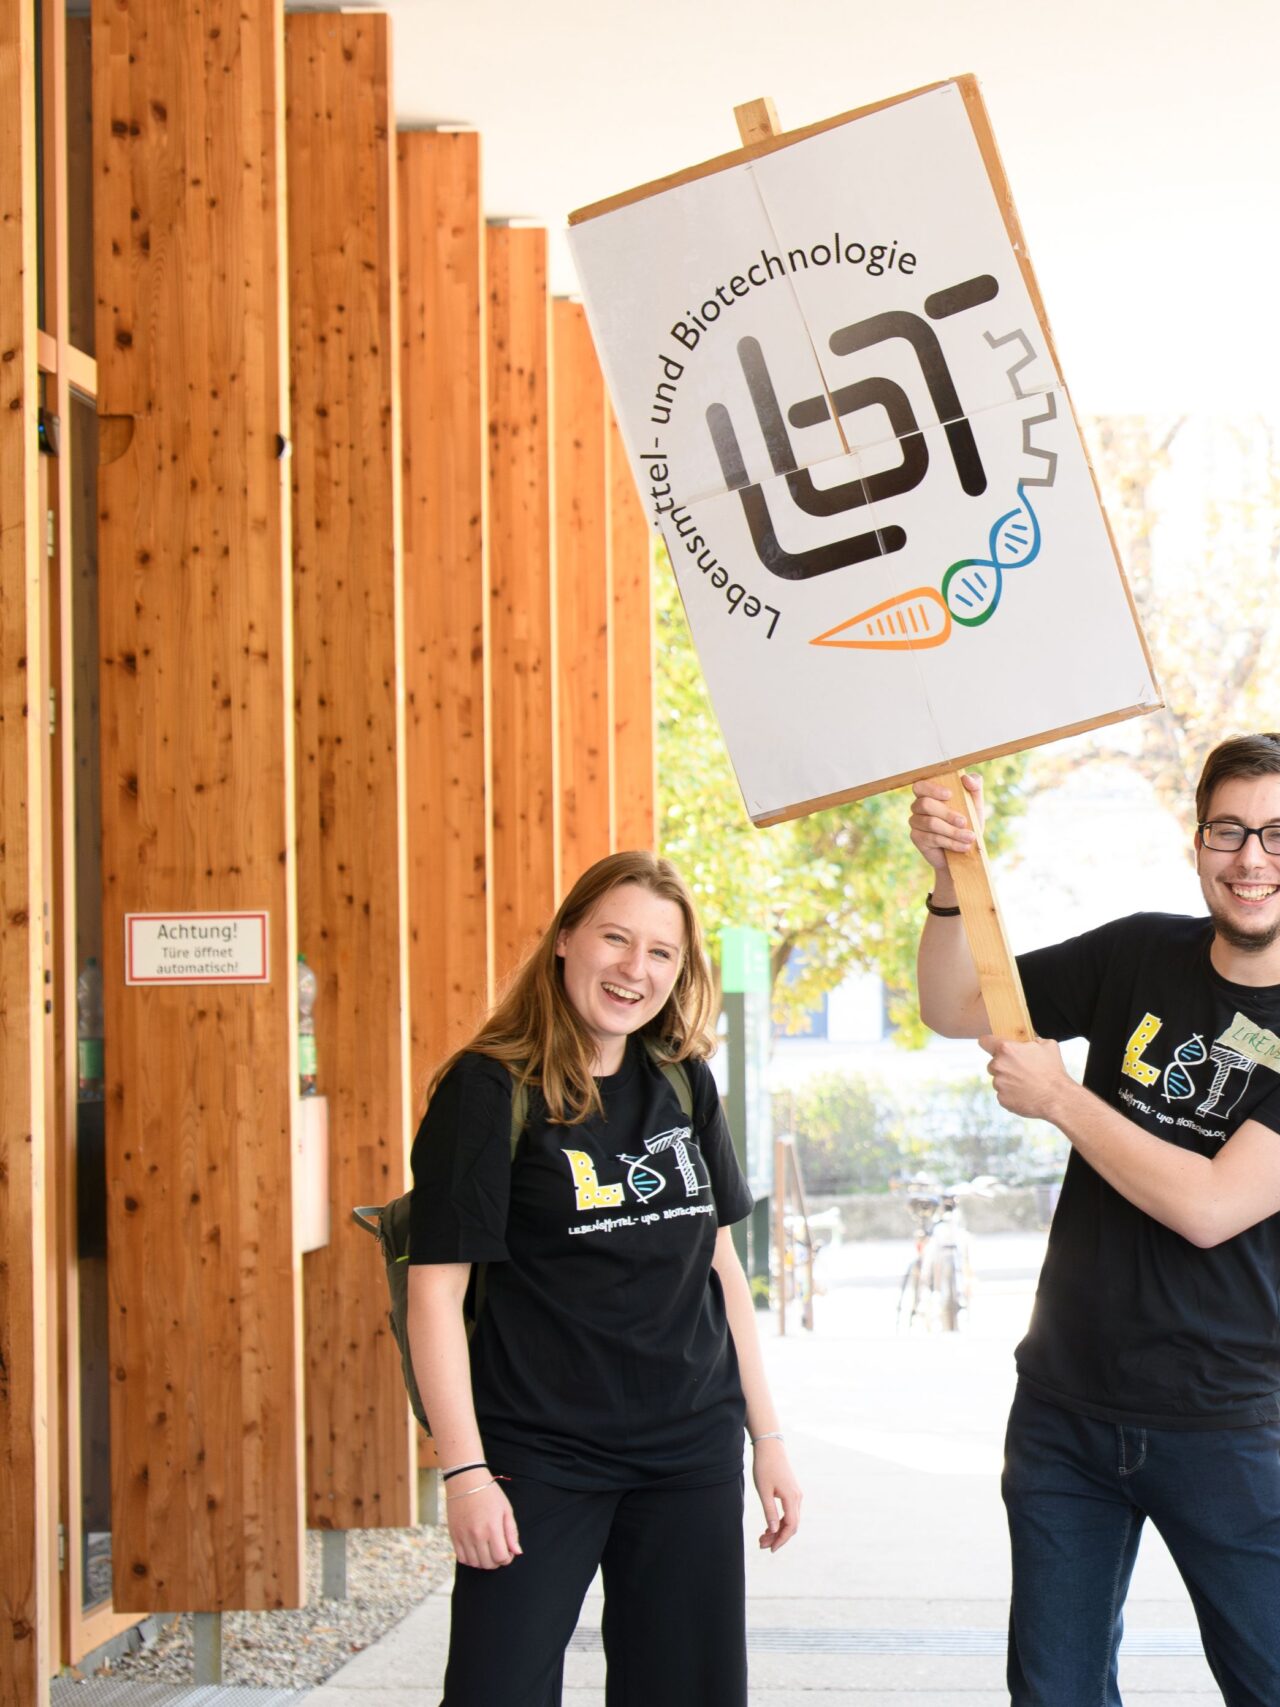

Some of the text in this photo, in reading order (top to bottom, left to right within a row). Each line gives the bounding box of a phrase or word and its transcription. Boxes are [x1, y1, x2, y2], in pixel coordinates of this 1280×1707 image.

[639, 232, 918, 640] Lebensmttel- und Biotechnologie
[157, 922, 238, 943] Achtung!
[162, 947, 233, 959] Türe öffnet
[156, 962, 239, 975] automatisch!
